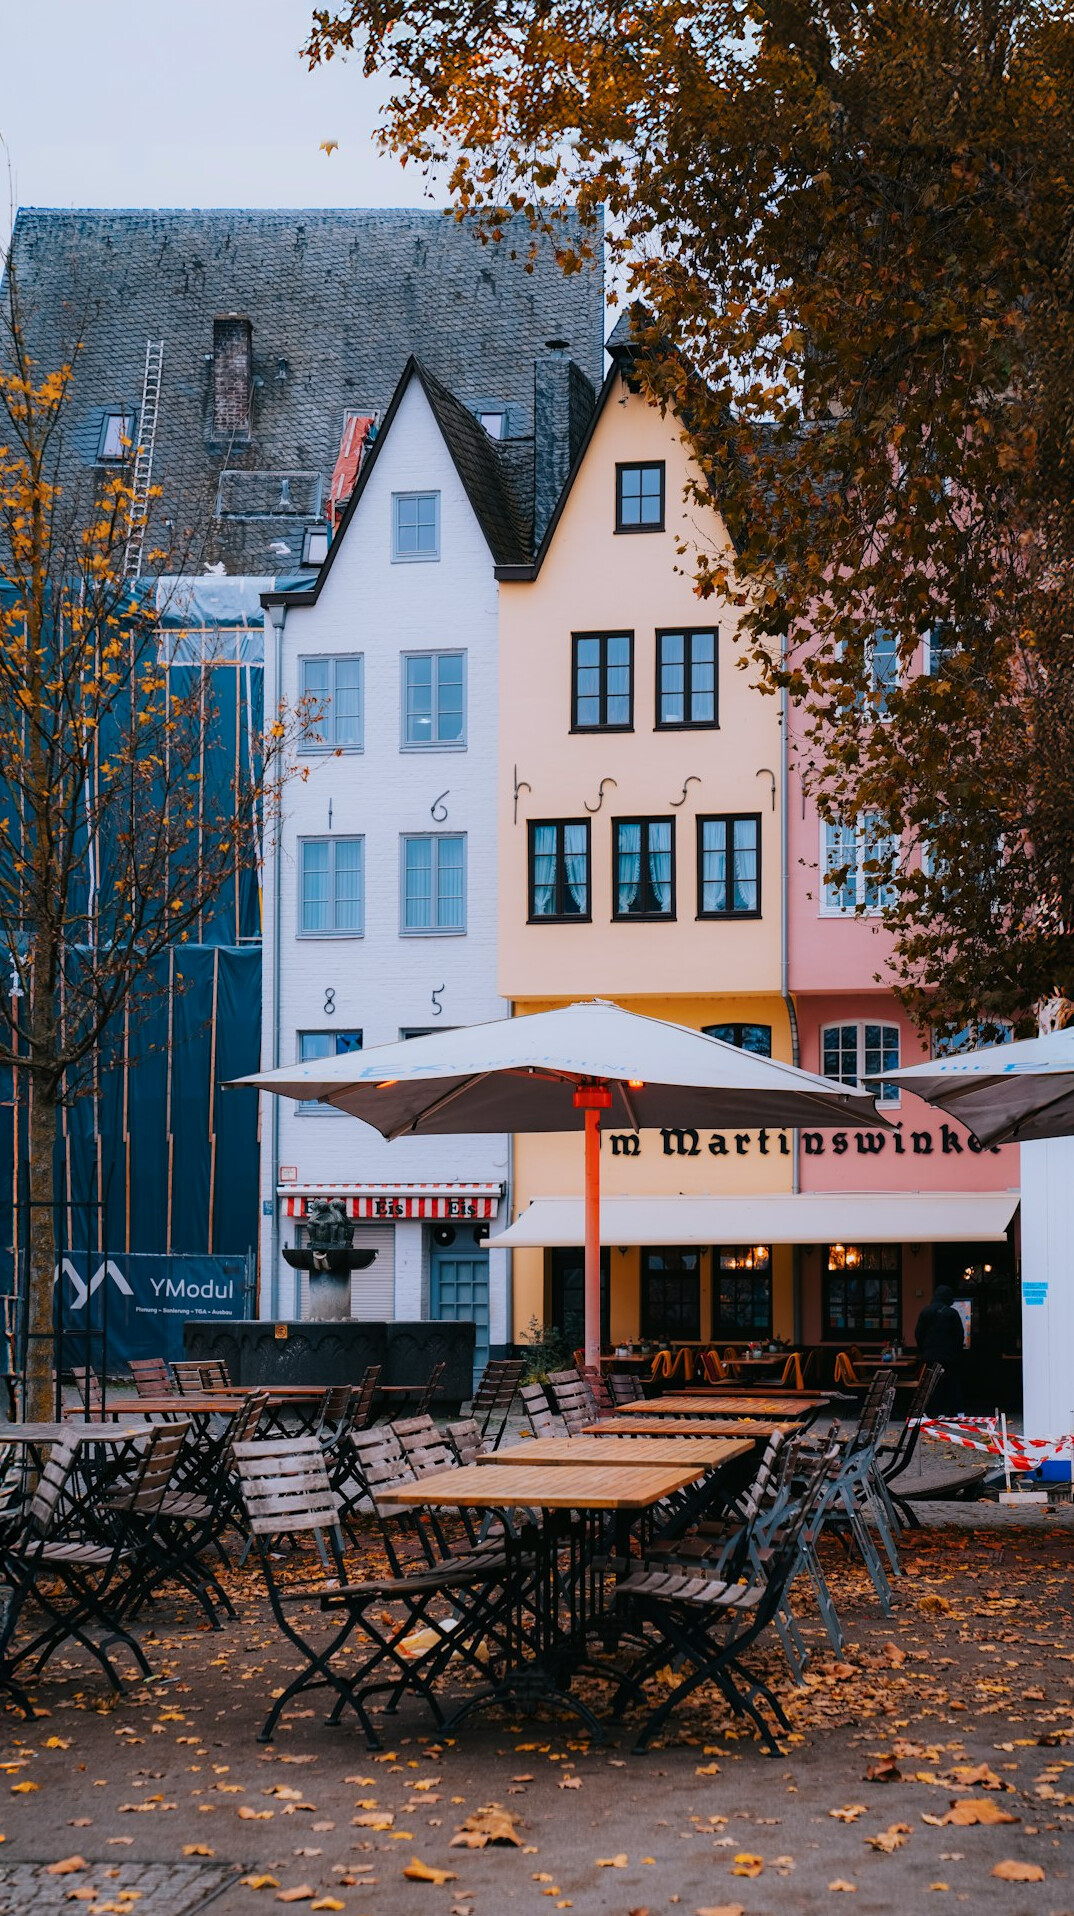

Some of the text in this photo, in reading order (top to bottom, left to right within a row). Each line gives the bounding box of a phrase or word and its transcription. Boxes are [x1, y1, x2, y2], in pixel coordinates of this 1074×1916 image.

[660, 1122, 1001, 1155] Martinswinke
[375, 1201, 477, 1215] Eis Eis
[150, 1278, 233, 1299] YModul
